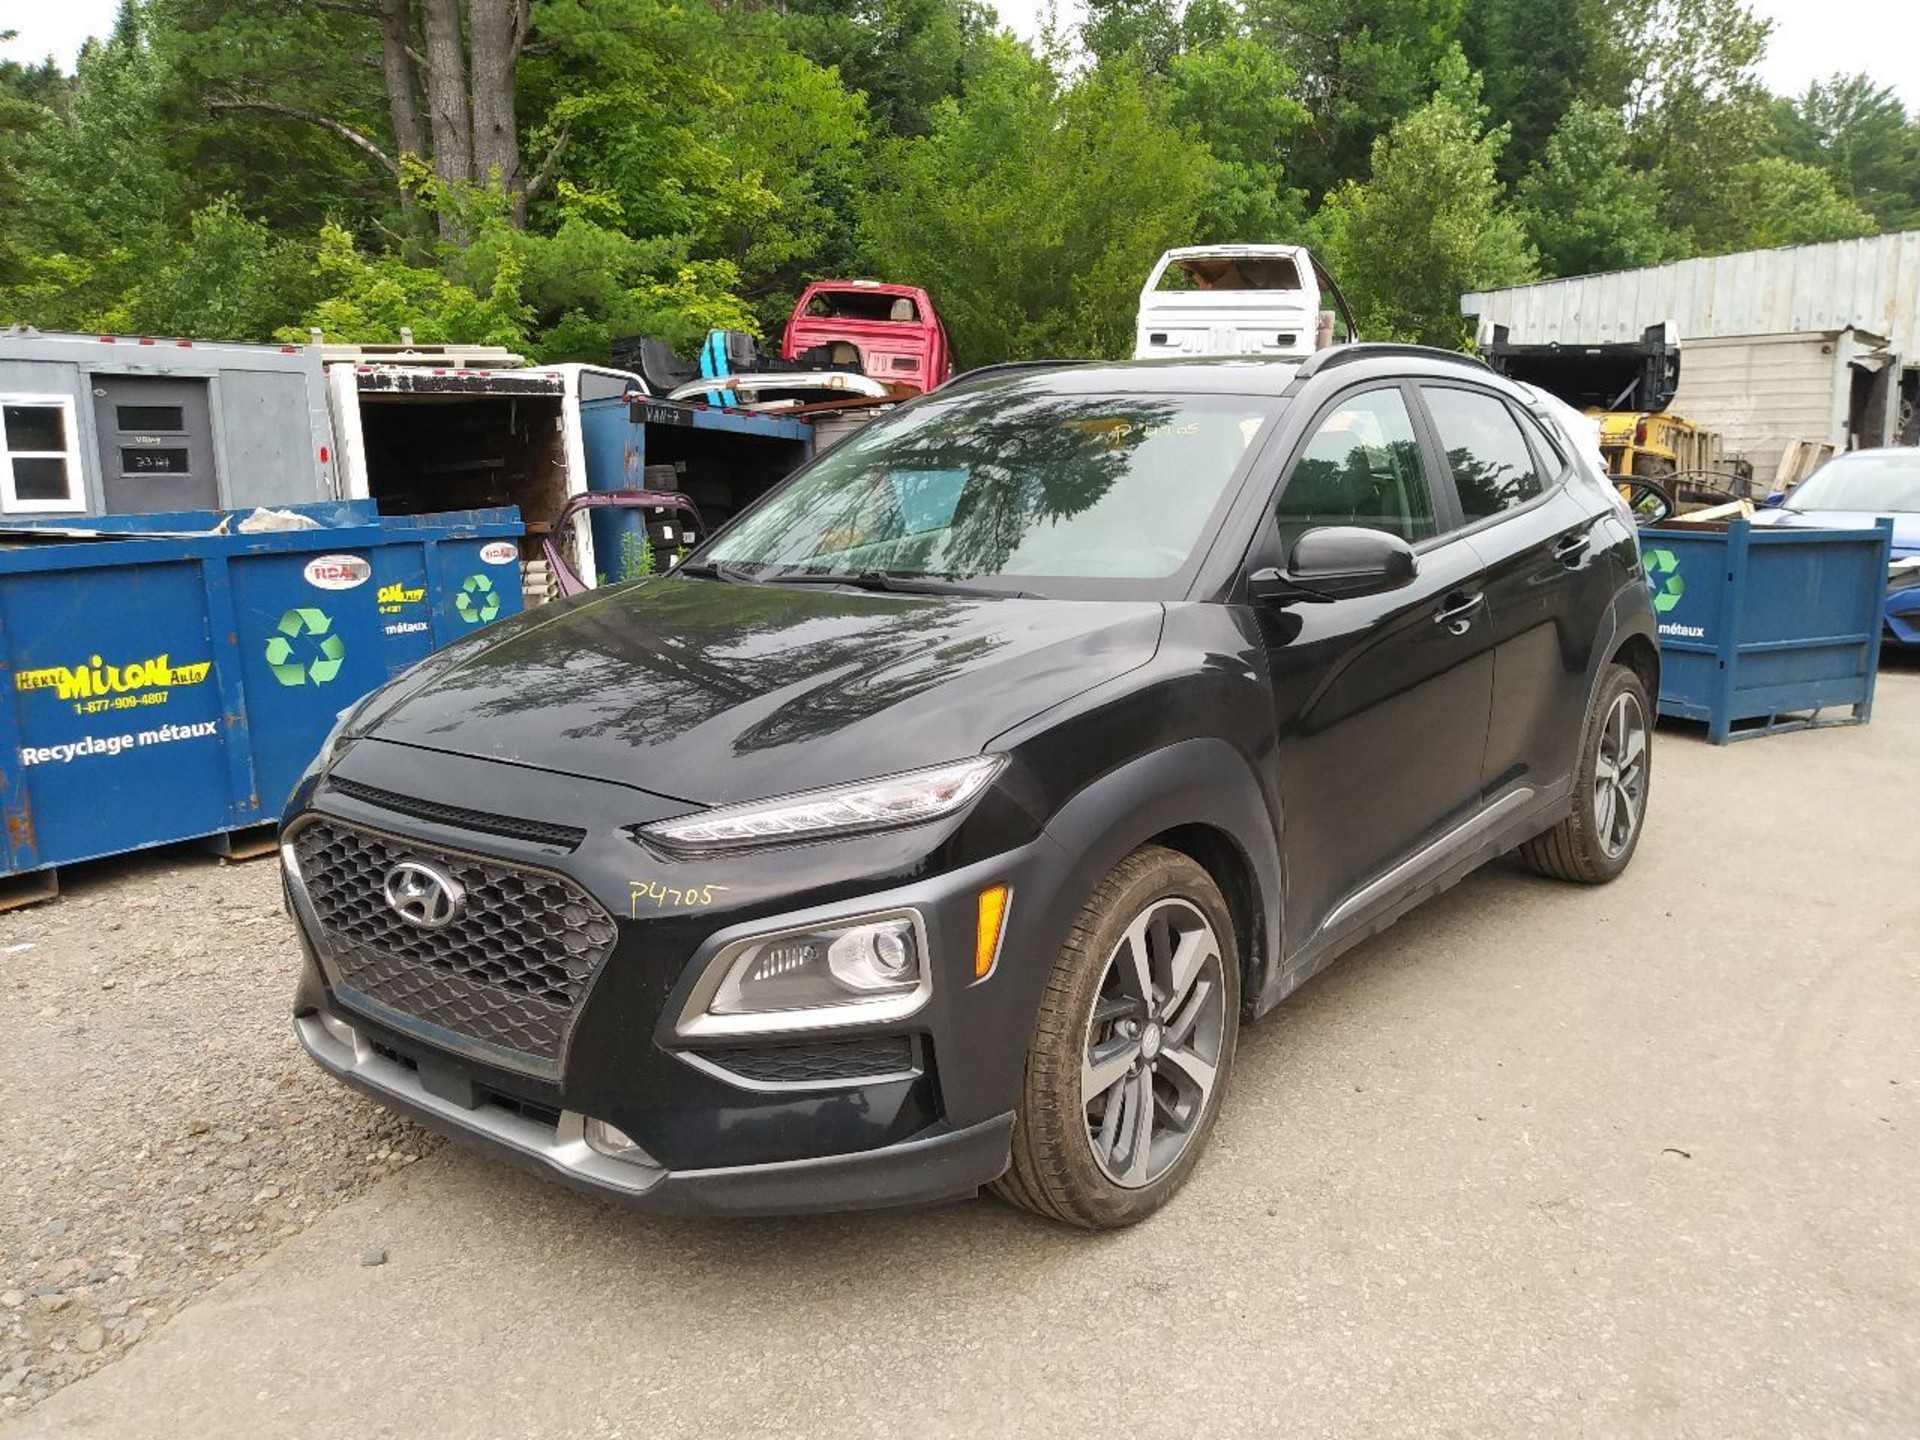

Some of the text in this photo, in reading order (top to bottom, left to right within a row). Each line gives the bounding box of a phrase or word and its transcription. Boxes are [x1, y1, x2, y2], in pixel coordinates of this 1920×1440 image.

[384, 622, 428, 635] métaux
[1658, 622, 1705, 638] métaux
[19, 671, 66, 689] Henri
[170, 670, 203, 686] Auto
[74, 691, 169, 715] 1-877-909-4807
[21, 720, 218, 766] Recyclage métaux
[629, 881, 731, 921] P4705
